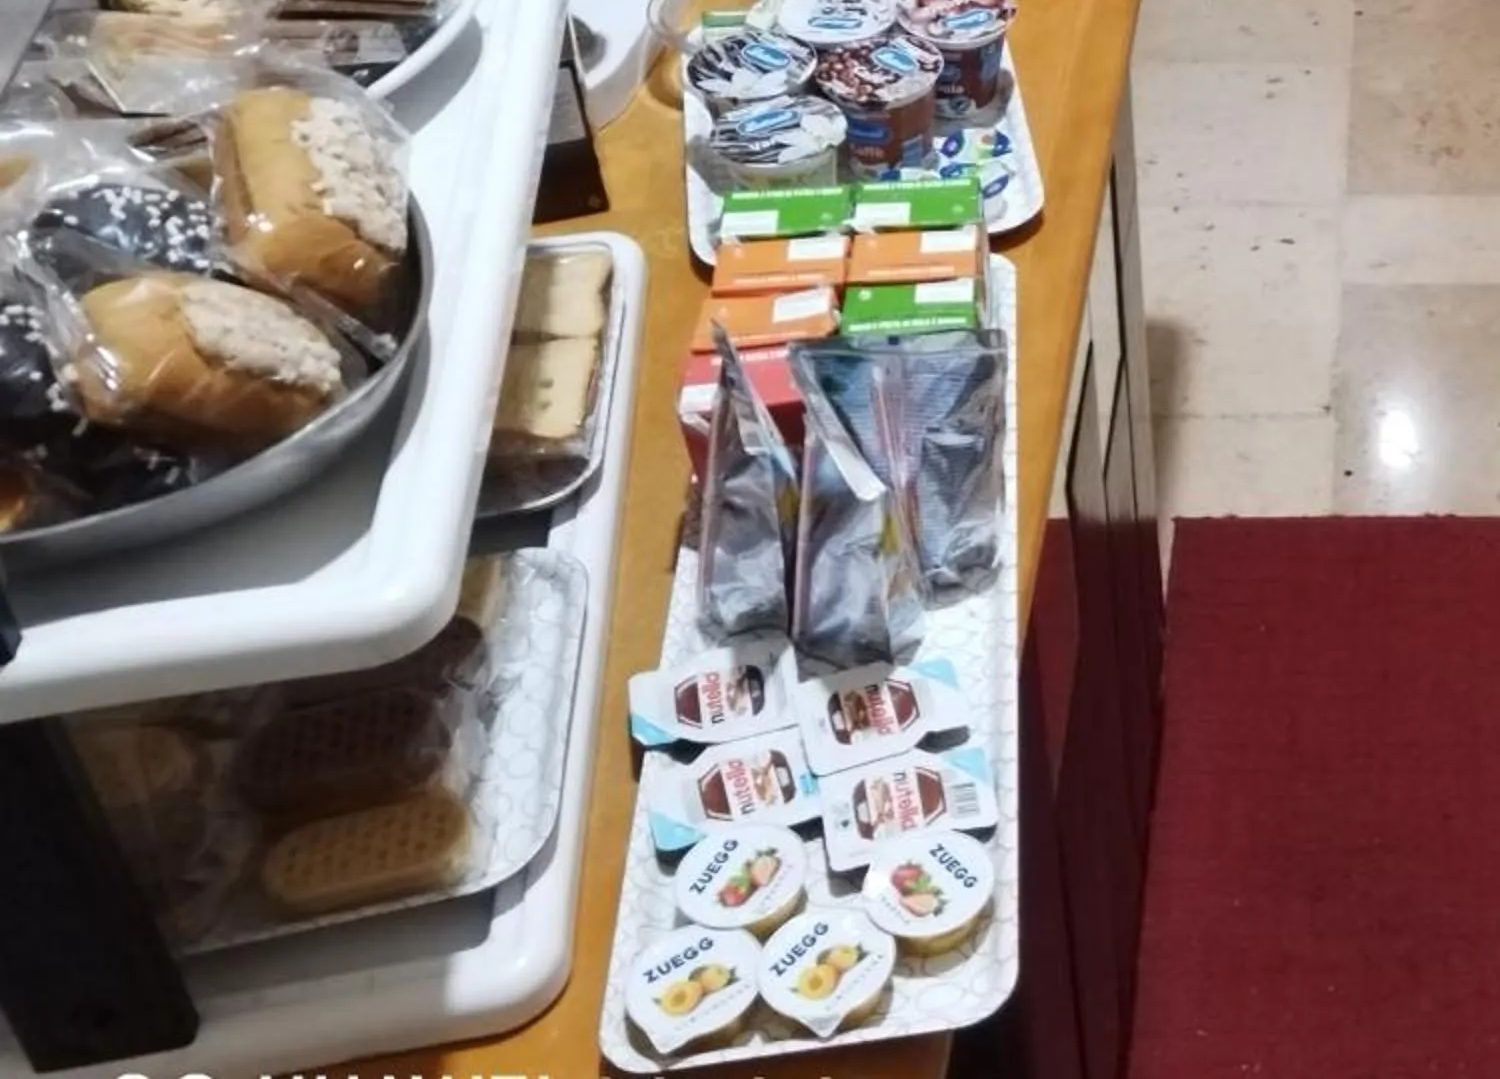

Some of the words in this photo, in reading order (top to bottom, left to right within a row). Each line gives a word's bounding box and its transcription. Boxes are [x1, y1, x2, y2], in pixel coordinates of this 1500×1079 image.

[701, 672, 725, 724] nutella
[865, 684, 895, 735] nutella
[727, 760, 755, 814] nutella
[689, 839, 739, 894] ZUEGG
[929, 843, 979, 889] ZUEGG
[642, 936, 714, 983] ZUEGG
[769, 922, 829, 977] ZUEGG
